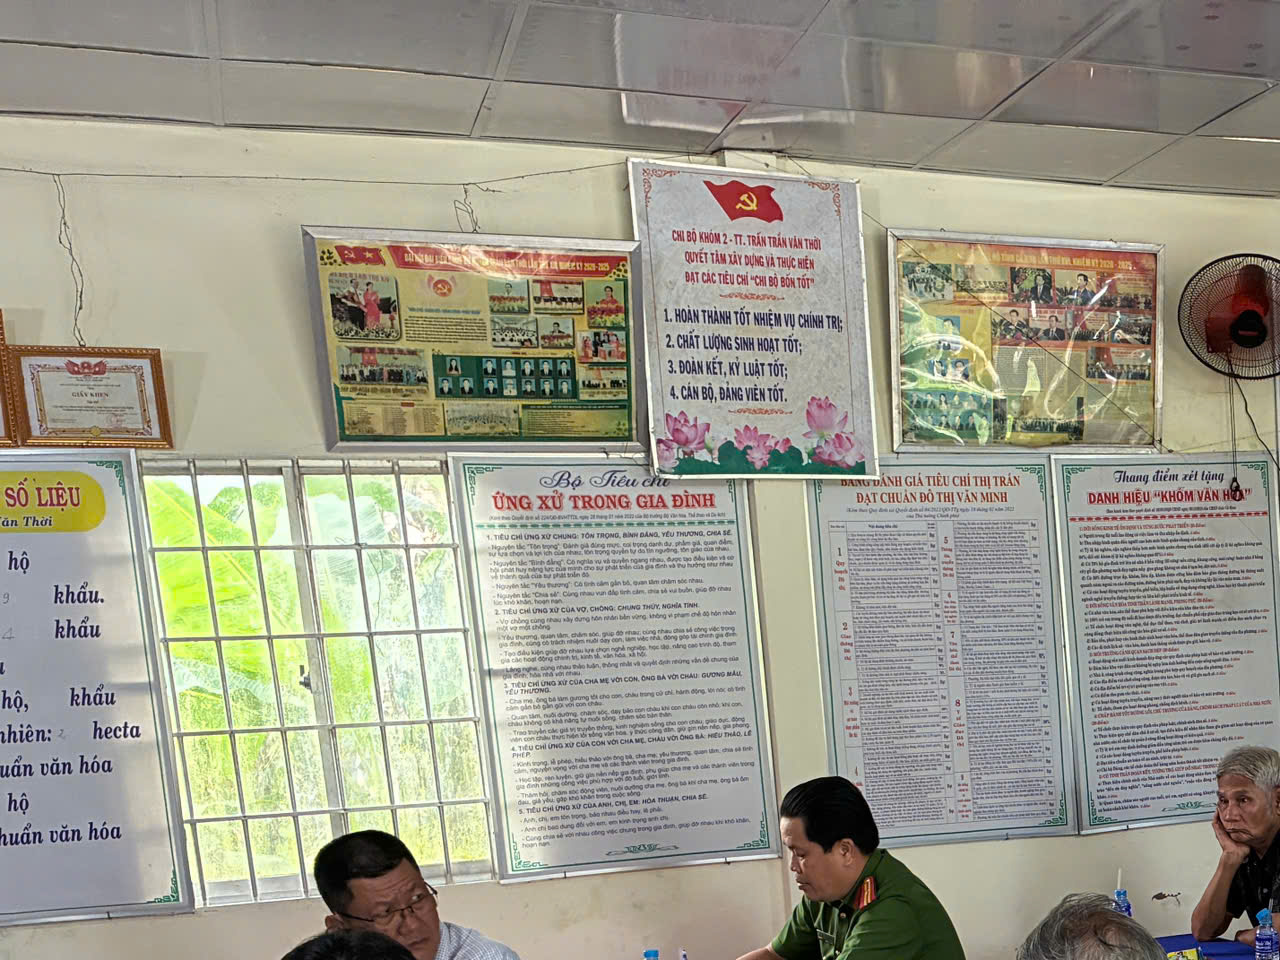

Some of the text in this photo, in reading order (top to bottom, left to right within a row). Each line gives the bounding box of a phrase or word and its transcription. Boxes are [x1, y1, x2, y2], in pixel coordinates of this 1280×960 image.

[672, 230, 684, 242] CHI
[687, 229, 697, 245] BỘ
[722, 233, 728, 244] 2
[733, 234, 746, 246] TT.
[685, 247, 815, 271] QUYẾT TÂM XÂY DỰNG VÀ THỰC HIỆN
[685, 271, 699, 285] ĐẠT
[702, 269, 716, 284] CÁC
[718, 270, 735, 285] TIÊU
[736, 271, 749, 286] CHÍ
[768, 273, 778, 289] BỘ
[780, 273, 795, 288] BỐN
[664, 305, 843, 332] 1. HOÀN THÀNH TỐT NHIỆM VỤ CHÍNH TRỊ;
[666, 329, 802, 355] 2. CHẤT LƯỢNG SINH HOẠT TỐT;
[668, 355, 788, 379] 3. ĐOÀN KẾT, KỶ LUẬT TỐT;
[670, 381, 788, 403] 4. CÁN BỘ, ĐẢNG VIÊN TỐT.
[540, 471, 583, 490] Bộ
[589, 470, 639, 488] Tiêu
[905, 472, 924, 487] GIÁ
[926, 473, 949, 487] TIÊU
[952, 472, 971, 487] CHÍ
[973, 476, 991, 489] THỊ
[994, 473, 1020, 487] TRẤN
[1113, 467, 1224, 484] Thang điểm xét tặng
[5, 477, 81, 511] SỐ LIỆU
[492, 489, 716, 511] ỨNG XỬ TRONG GIA ĐÌNH
[856, 489, 1008, 505] ĐẠT CHUẨN ĐÔ THỊ VĂN MINH
[1088, 491, 1120, 504] DANH
[1123, 489, 1151, 506] HIỆU
[1197, 488, 1220, 502] VĂN
[0, 516, 53, 527] ăn Thời
[8, 551, 30, 574] hộ
[53, 581, 105, 604] khẩu.
[54, 616, 101, 639] khẩu
[1, 684, 116, 712] hộ, khẩu
[93, 721, 141, 740] hecta
[0, 754, 113, 778] uẩn văn hóa
[7, 792, 29, 815] hộ
[0, 821, 122, 846] huẩn văn hóa
